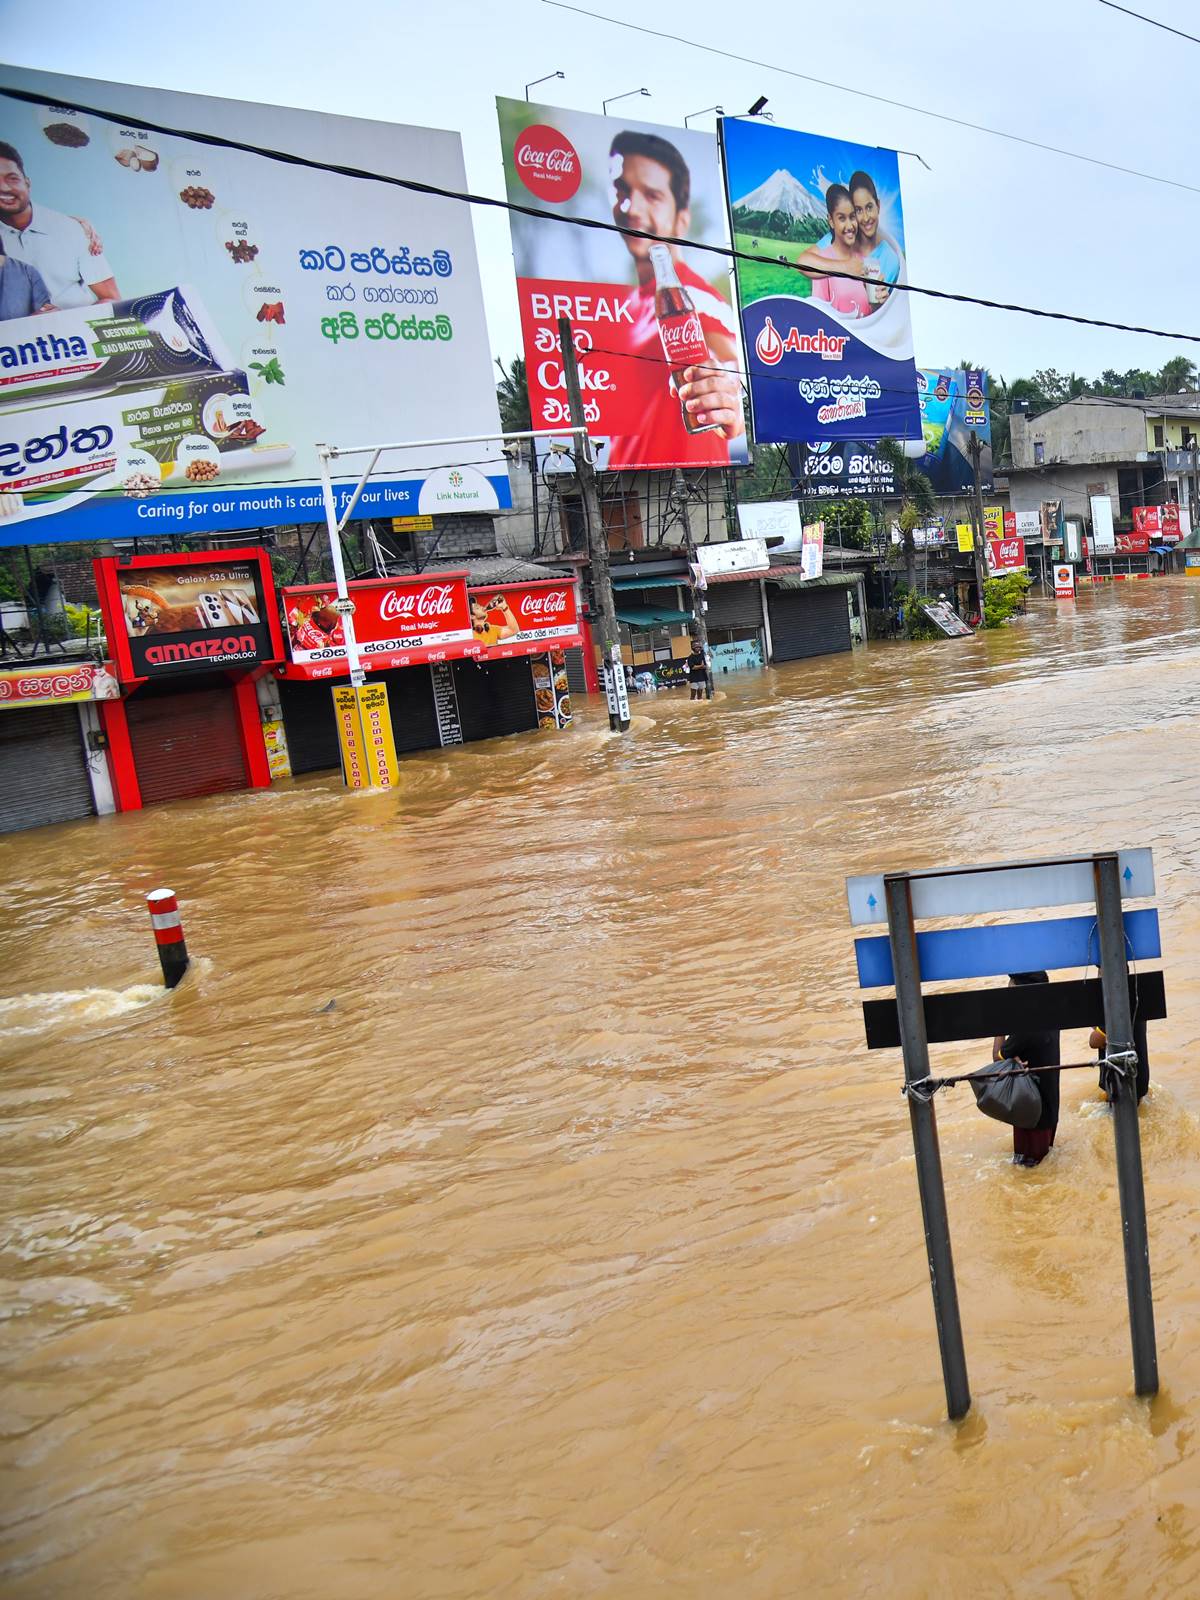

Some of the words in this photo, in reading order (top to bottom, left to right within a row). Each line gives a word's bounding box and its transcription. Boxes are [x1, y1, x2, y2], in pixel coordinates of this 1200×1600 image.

[518, 144, 575, 173] Coca-Cola
[299, 245, 345, 272] කට
[350, 246, 453, 277] පරිස්සම්
[326, 282, 356, 301] කර
[363, 284, 439, 305] ගත්තොත්
[531, 294, 635, 323] BREAK
[103, 327, 140, 338] DESTROY
[321, 311, 359, 344] අපි
[364, 312, 453, 342] පරිස්සම්
[101, 343, 118, 354] BAD
[119, 339, 154, 352] BACTERIA
[534, 327, 593, 353] එට
[784, 328, 846, 353] Anchor
[542, 397, 600, 423] එක්
[137, 504, 185, 521] Caring
[188, 502, 207, 519] for
[212, 500, 236, 513] our
[239, 495, 283, 511] mouth
[286, 495, 296, 507] is
[341, 492, 353, 508] fo
[361, 492, 381, 503] our
[384, 489, 410, 502] lives
[436, 492, 452, 501] Link
[454, 491, 479, 499] Natural
[1000, 541, 1019, 558] Coca-Cola
[177, 576, 207, 585] Galaxy
[210, 573, 226, 581] S25
[229, 572, 250, 580] Ultra
[380, 585, 455, 621] Coca-Cola
[521, 592, 567, 615] Coca-Cola
[400, 624, 417, 632] Real
[417, 621, 438, 630] Magic
[145, 635, 257, 664] amazon
[209, 650, 257, 663] TECHNOLOGY
[310, 648, 346, 660] පබස
[428, 652, 446, 661] Coca-Cola
[312, 667, 333, 677] Coca-Cola
[391, 657, 410, 666] Coca-Cola
